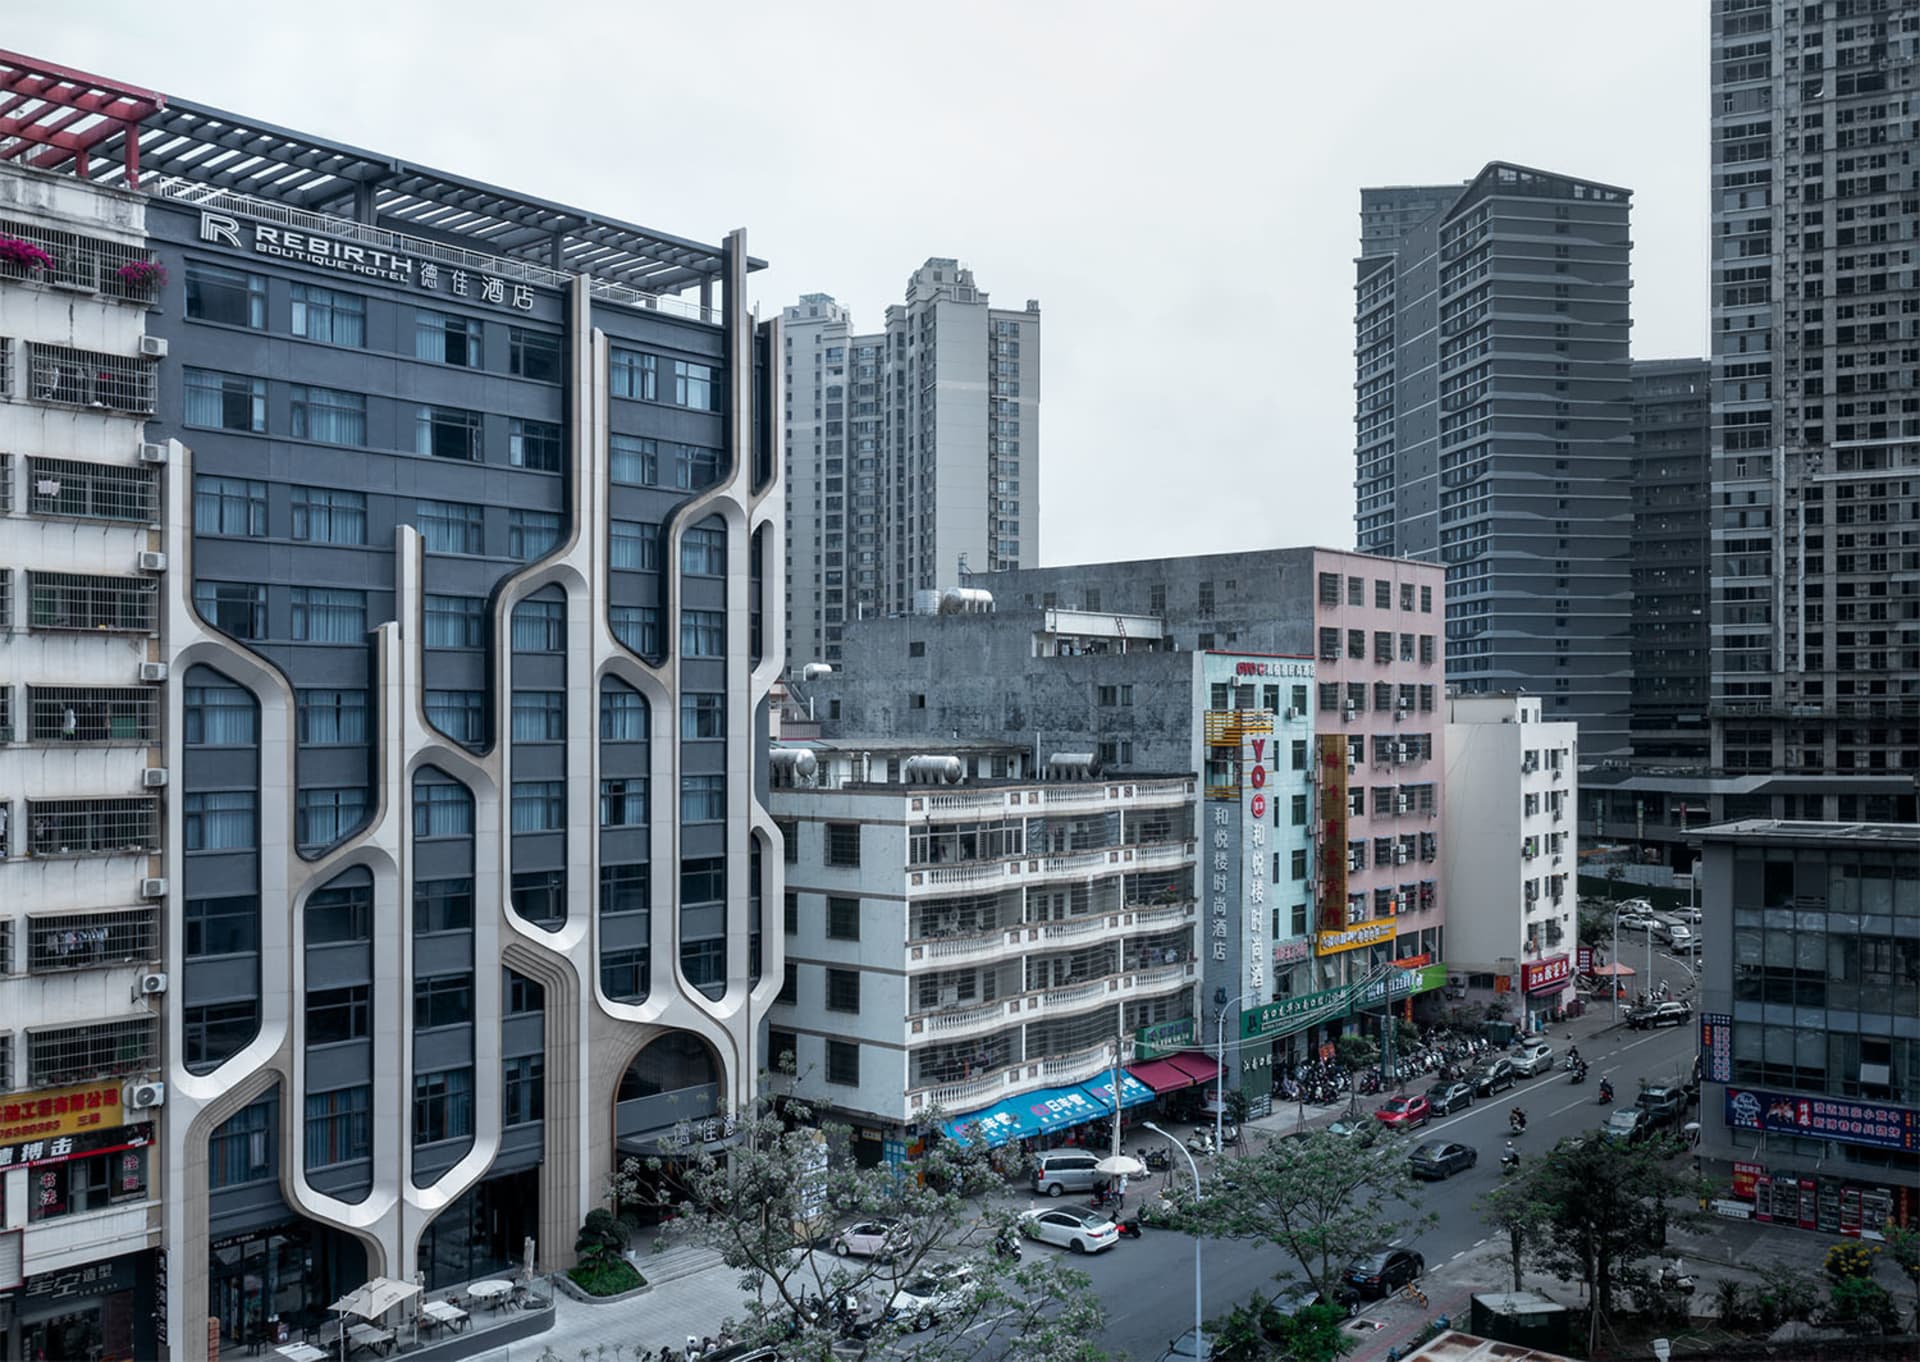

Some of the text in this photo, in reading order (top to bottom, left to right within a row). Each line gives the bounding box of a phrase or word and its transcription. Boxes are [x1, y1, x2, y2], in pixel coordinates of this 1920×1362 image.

[255, 223, 413, 273] REBIRTH
[255, 242, 410, 284] BOUTIQUE HOTEL
[420, 261, 536, 311] 德佳酒店
[1212, 807, 1229, 961] 和悦楼时尚酒店
[1045, 1093, 1086, 1113] 日丰管
